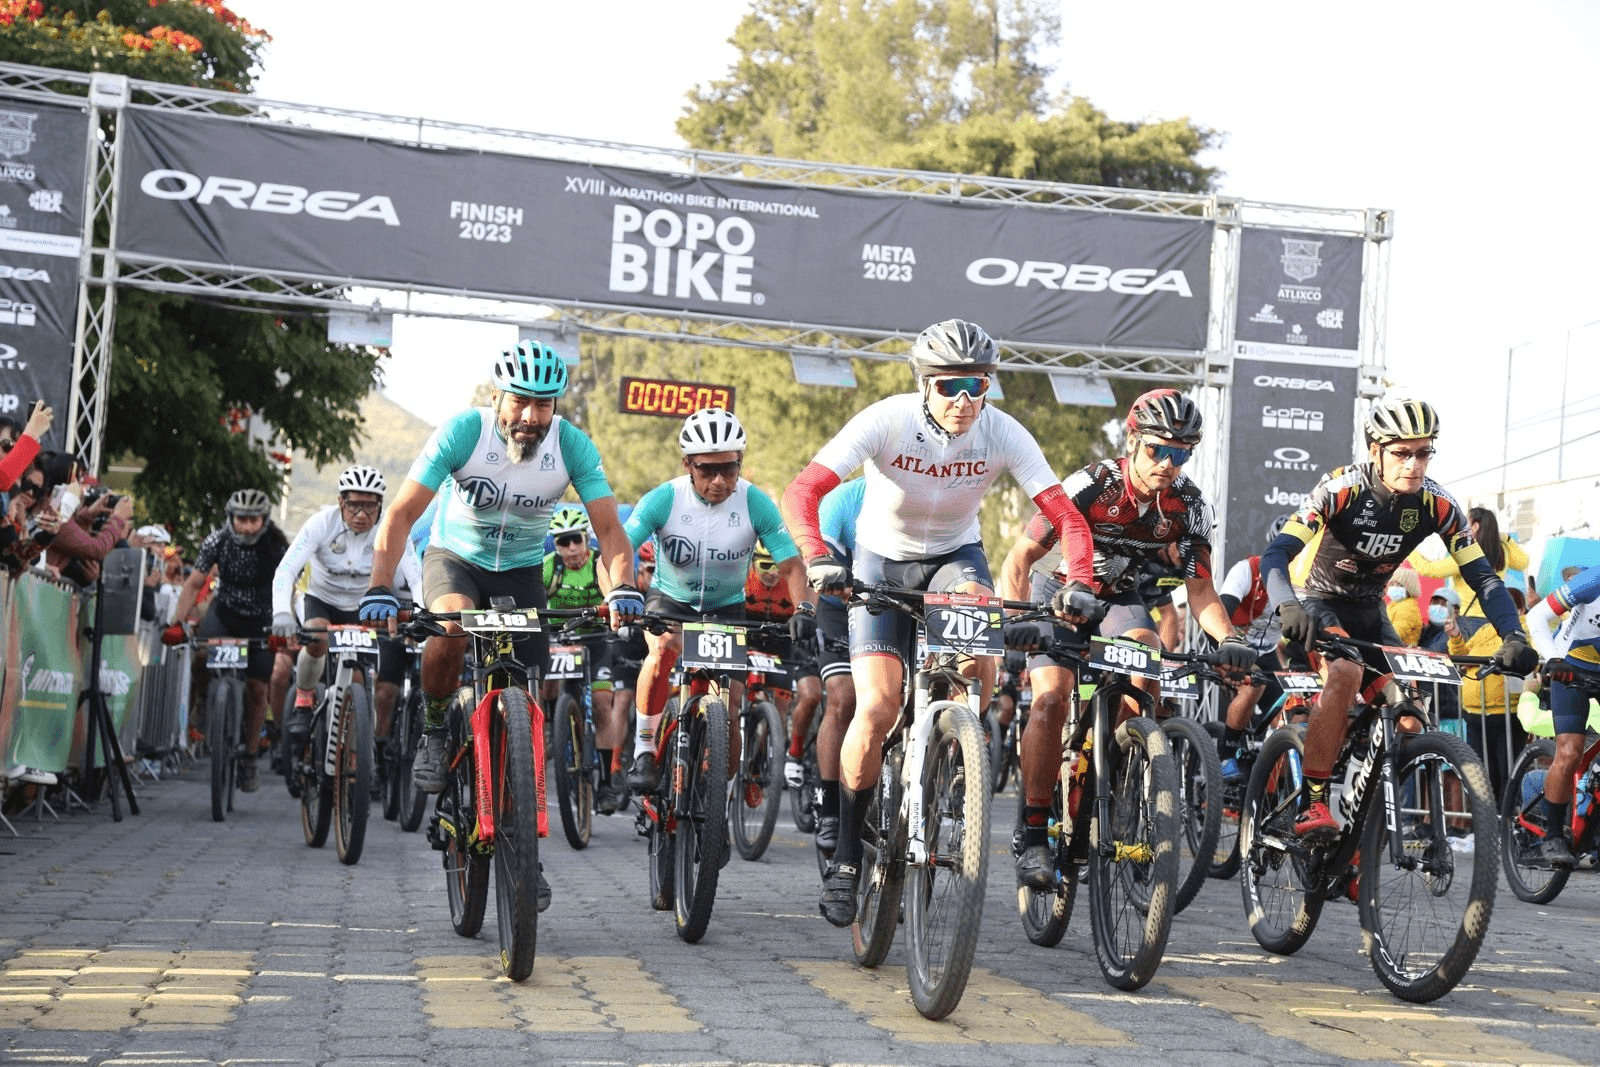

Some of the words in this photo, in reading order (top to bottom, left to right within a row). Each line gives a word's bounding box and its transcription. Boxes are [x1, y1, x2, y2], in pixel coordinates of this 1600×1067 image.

[140, 169, 400, 226] ORBEA
[565, 176, 604, 196] XVIII
[609, 185, 684, 205] MARATHON
[686, 194, 716, 209] BIKE
[717, 197, 819, 218] INTERNATIONAL
[450, 201, 523, 226] FINISH
[459, 221, 512, 243] 2023
[612, 204, 755, 255] POPO
[862, 243, 916, 265] META
[609, 242, 753, 304] BIKE
[863, 262, 914, 283] 2023
[965, 257, 1193, 297] ORBEA
[1277, 288, 1322, 301] ATLIXCO
[1253, 375, 1335, 392] ORBEA
[1262, 406, 1324, 420] GoPro
[890, 453, 987, 478] ATLANTIC
[1264, 460, 1318, 471] OAKLEY
[458, 480, 497, 508] MG
[664, 537, 693, 566] MG
[941, 609, 990, 641] 202
[698, 633, 733, 659] 631
[1103, 645, 1148, 669] 890
